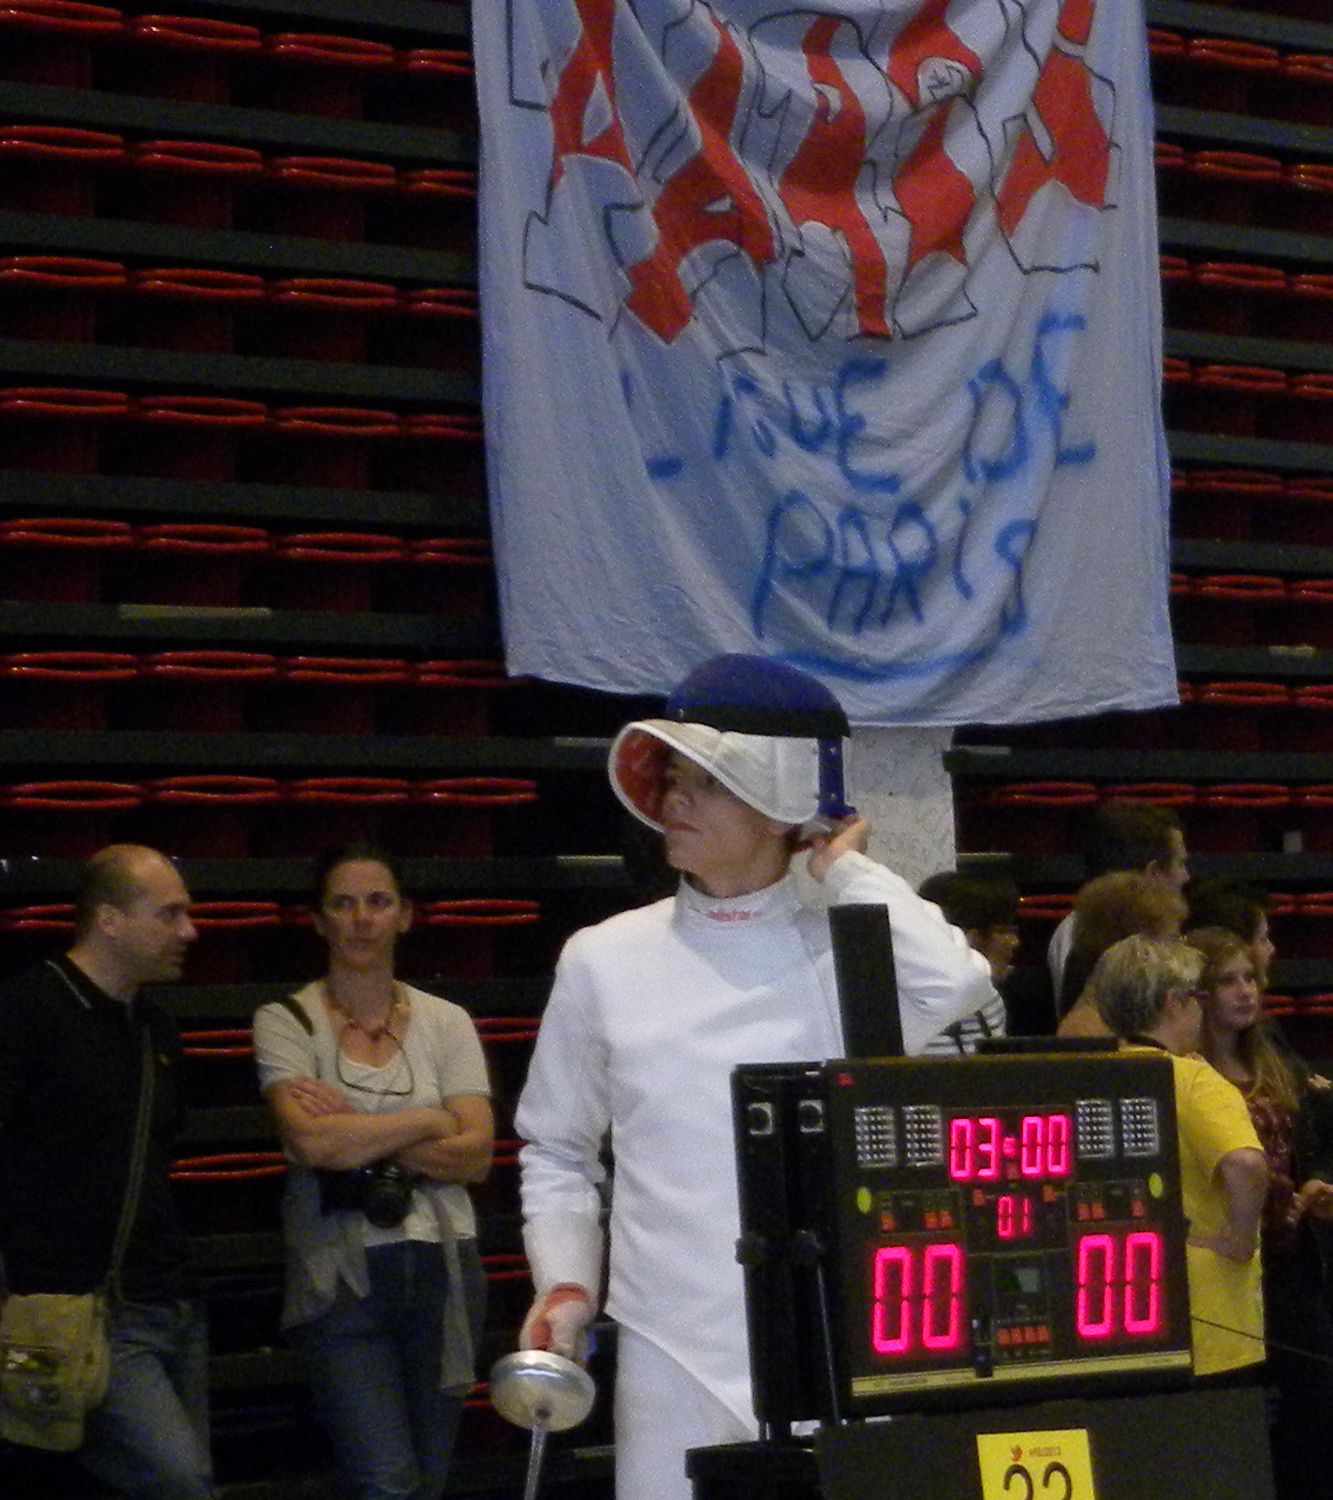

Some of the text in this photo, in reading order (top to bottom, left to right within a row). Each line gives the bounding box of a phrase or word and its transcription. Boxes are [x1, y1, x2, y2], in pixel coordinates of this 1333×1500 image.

[753, 489, 1038, 639] PARIS
[949, 1114, 1069, 1179] 03:00
[998, 1196, 1031, 1240] 01
[872, 1244, 962, 1353] 00
[1076, 1231, 1162, 1338] 00
